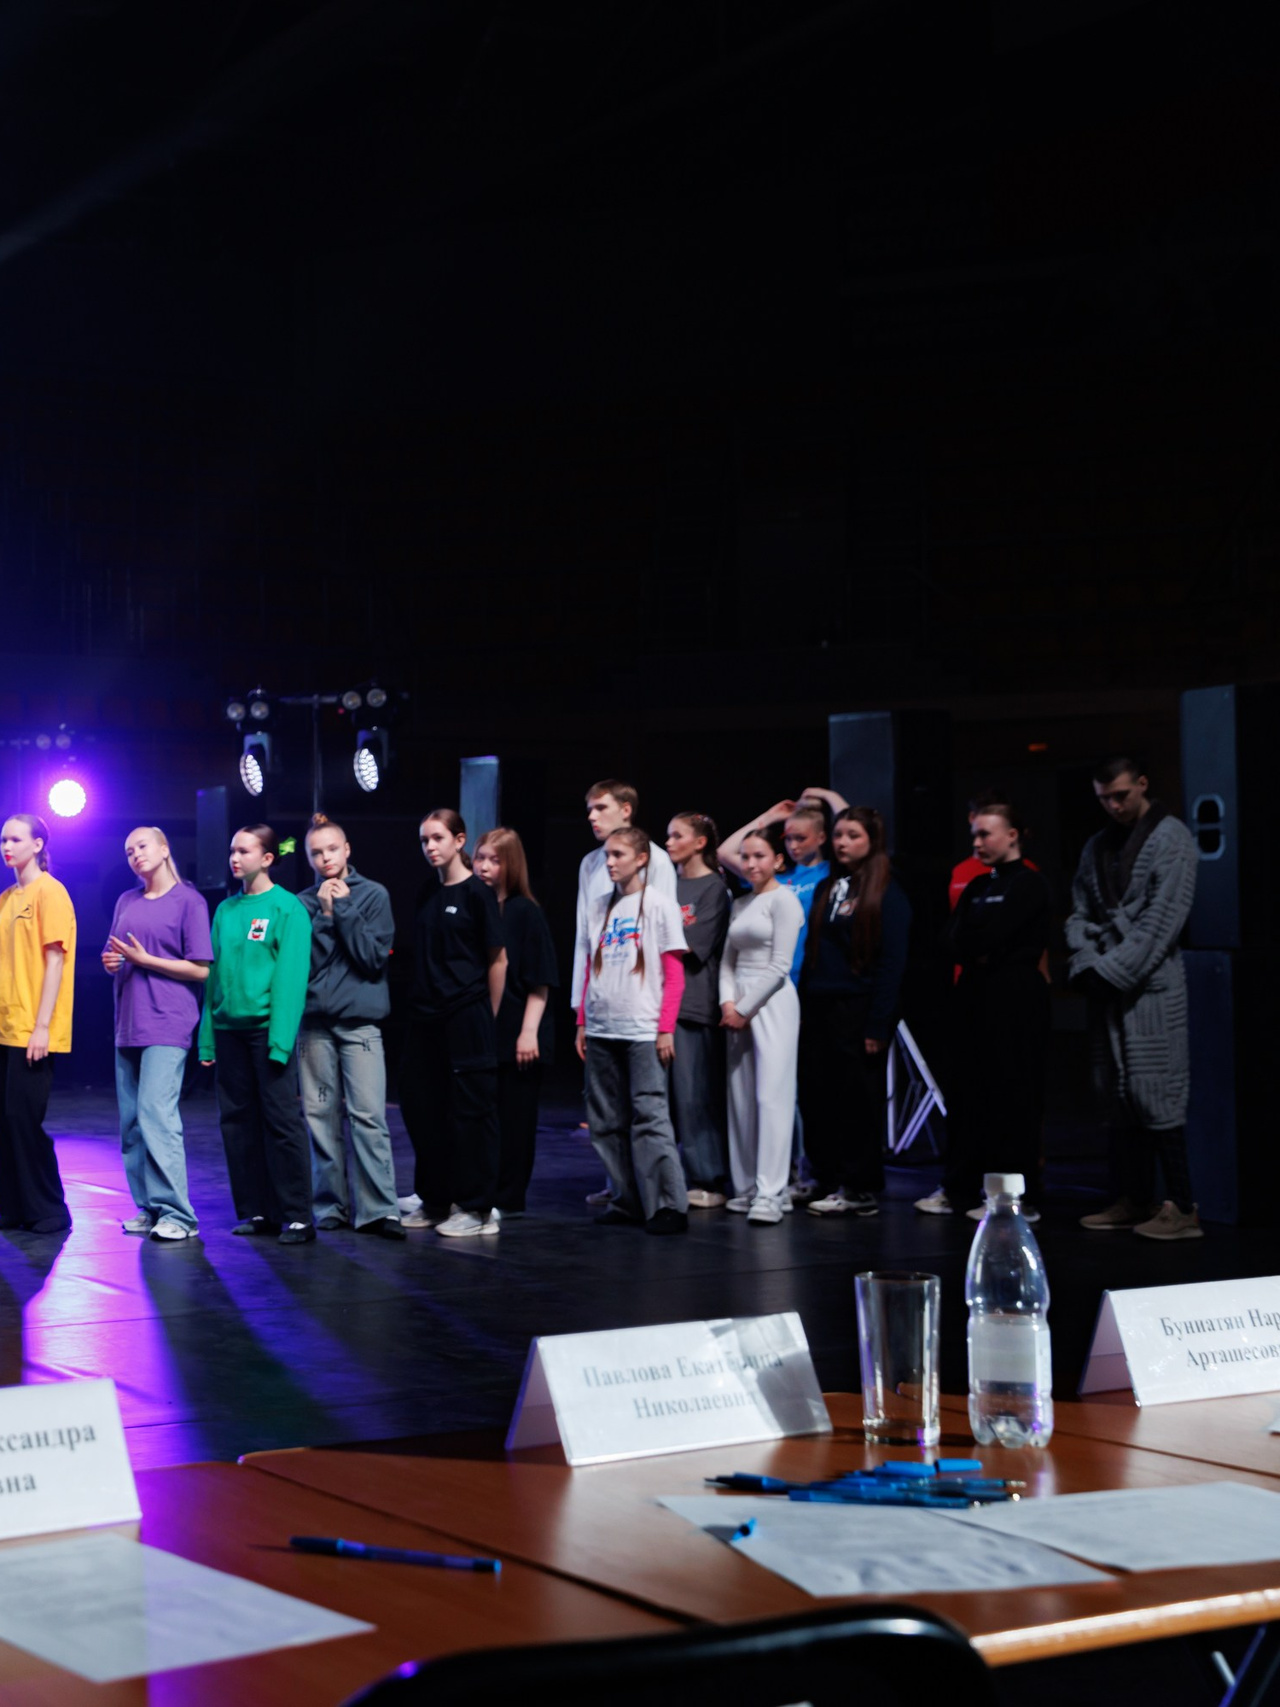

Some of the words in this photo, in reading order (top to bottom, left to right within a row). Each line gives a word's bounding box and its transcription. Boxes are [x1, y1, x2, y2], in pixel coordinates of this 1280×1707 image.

[1160, 1316, 1246, 1341] Буниатян
[1187, 1343, 1280, 1371] Арташесов
[582, 1364, 673, 1388] Павлова
